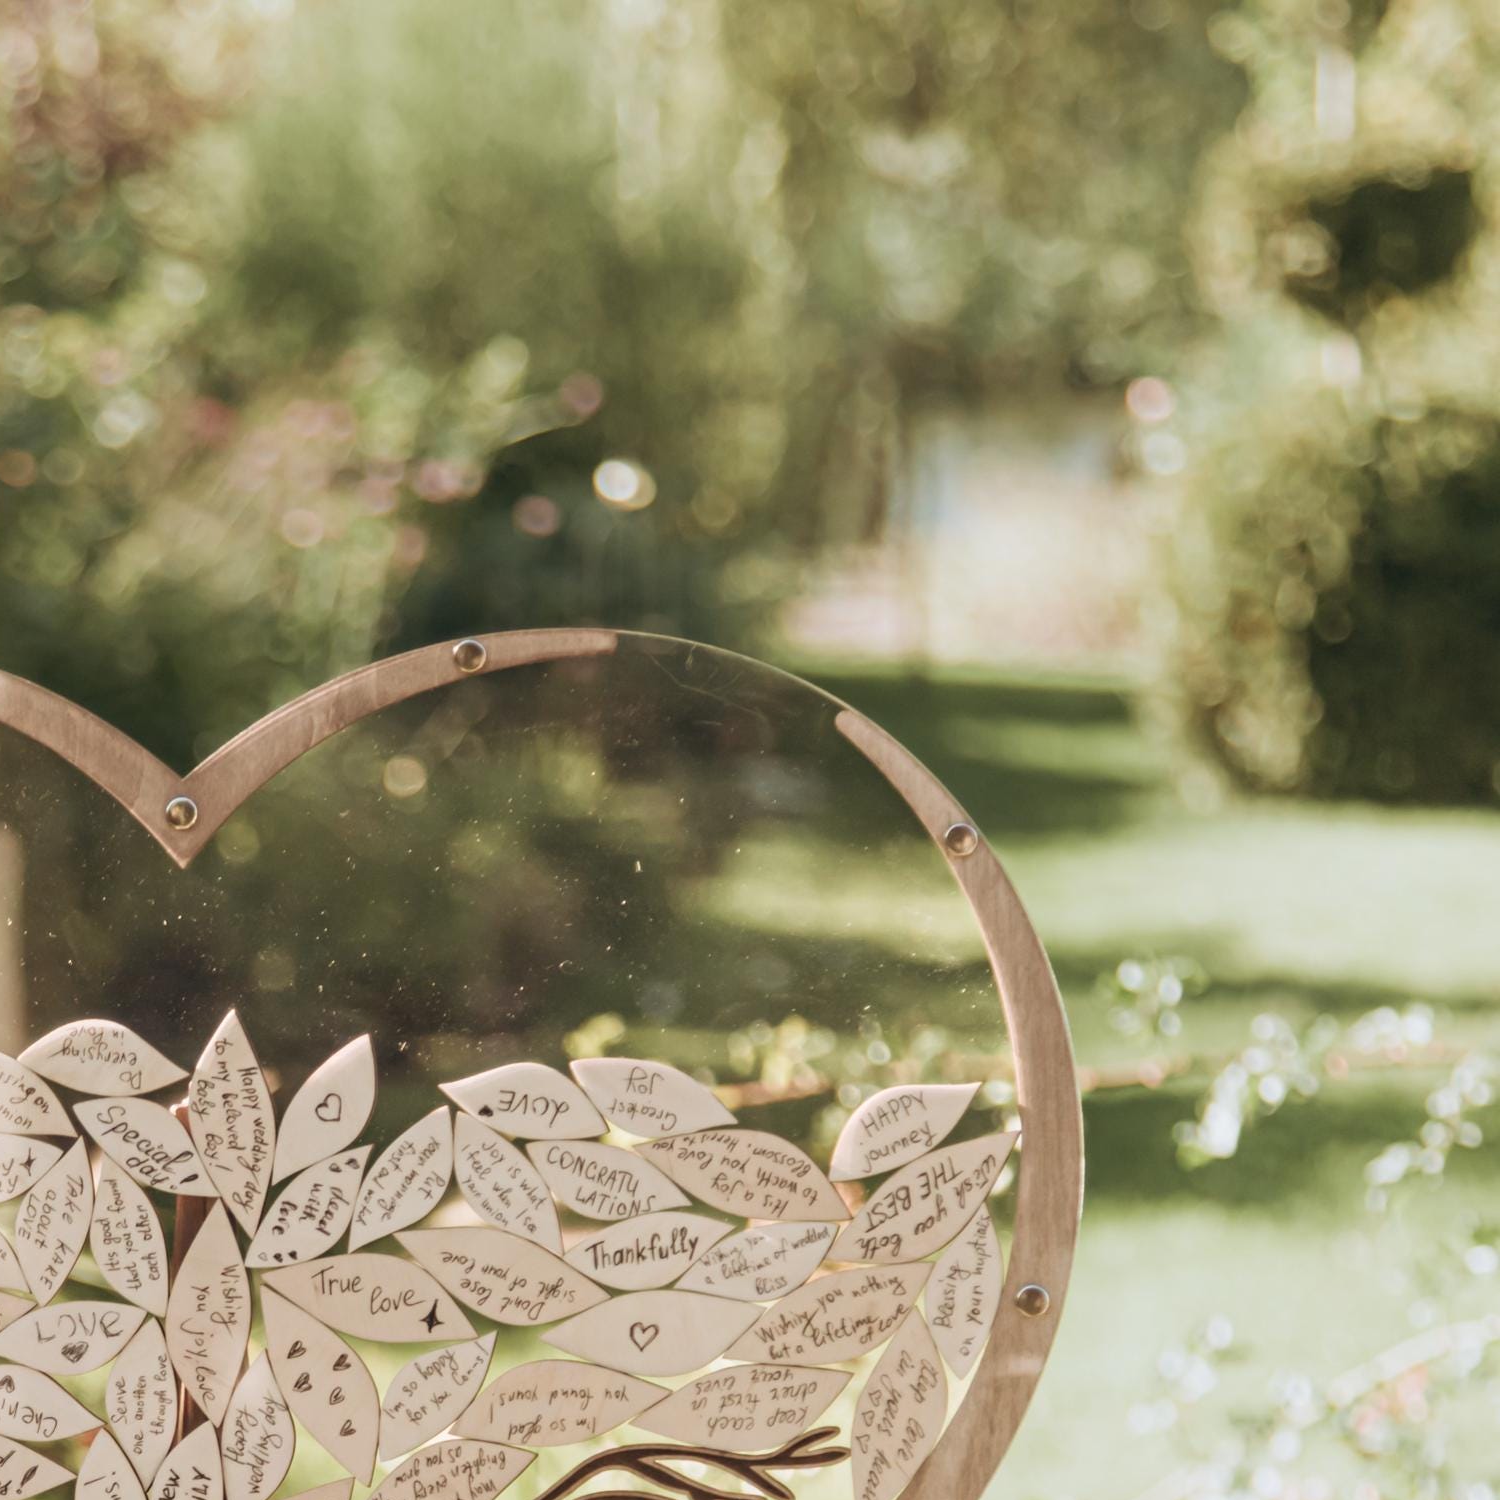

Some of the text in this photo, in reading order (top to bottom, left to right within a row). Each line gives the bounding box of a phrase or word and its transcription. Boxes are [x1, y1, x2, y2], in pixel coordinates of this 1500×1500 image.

[119, 1070, 142, 1090] Do
[212, 1038, 233, 1083] to my
[237, 1066, 261, 1112] Happy
[859, 1121, 938, 1173] journey
[18, 1194, 39, 1240] LOVE
[865, 1157, 964, 1233] THE BEST
[34, 1189, 57, 1248] about
[441, 1251, 476, 1273] love
[585, 1227, 699, 1269] Thankfully
[191, 1285, 210, 1312] you
[210, 1264, 243, 1338] Wishing
[311, 1265, 427, 1315] True love
[817, 1275, 907, 1312] you nothing
[795, 1315, 879, 1354] a lifetime
[133, 1431, 145, 1455] one
